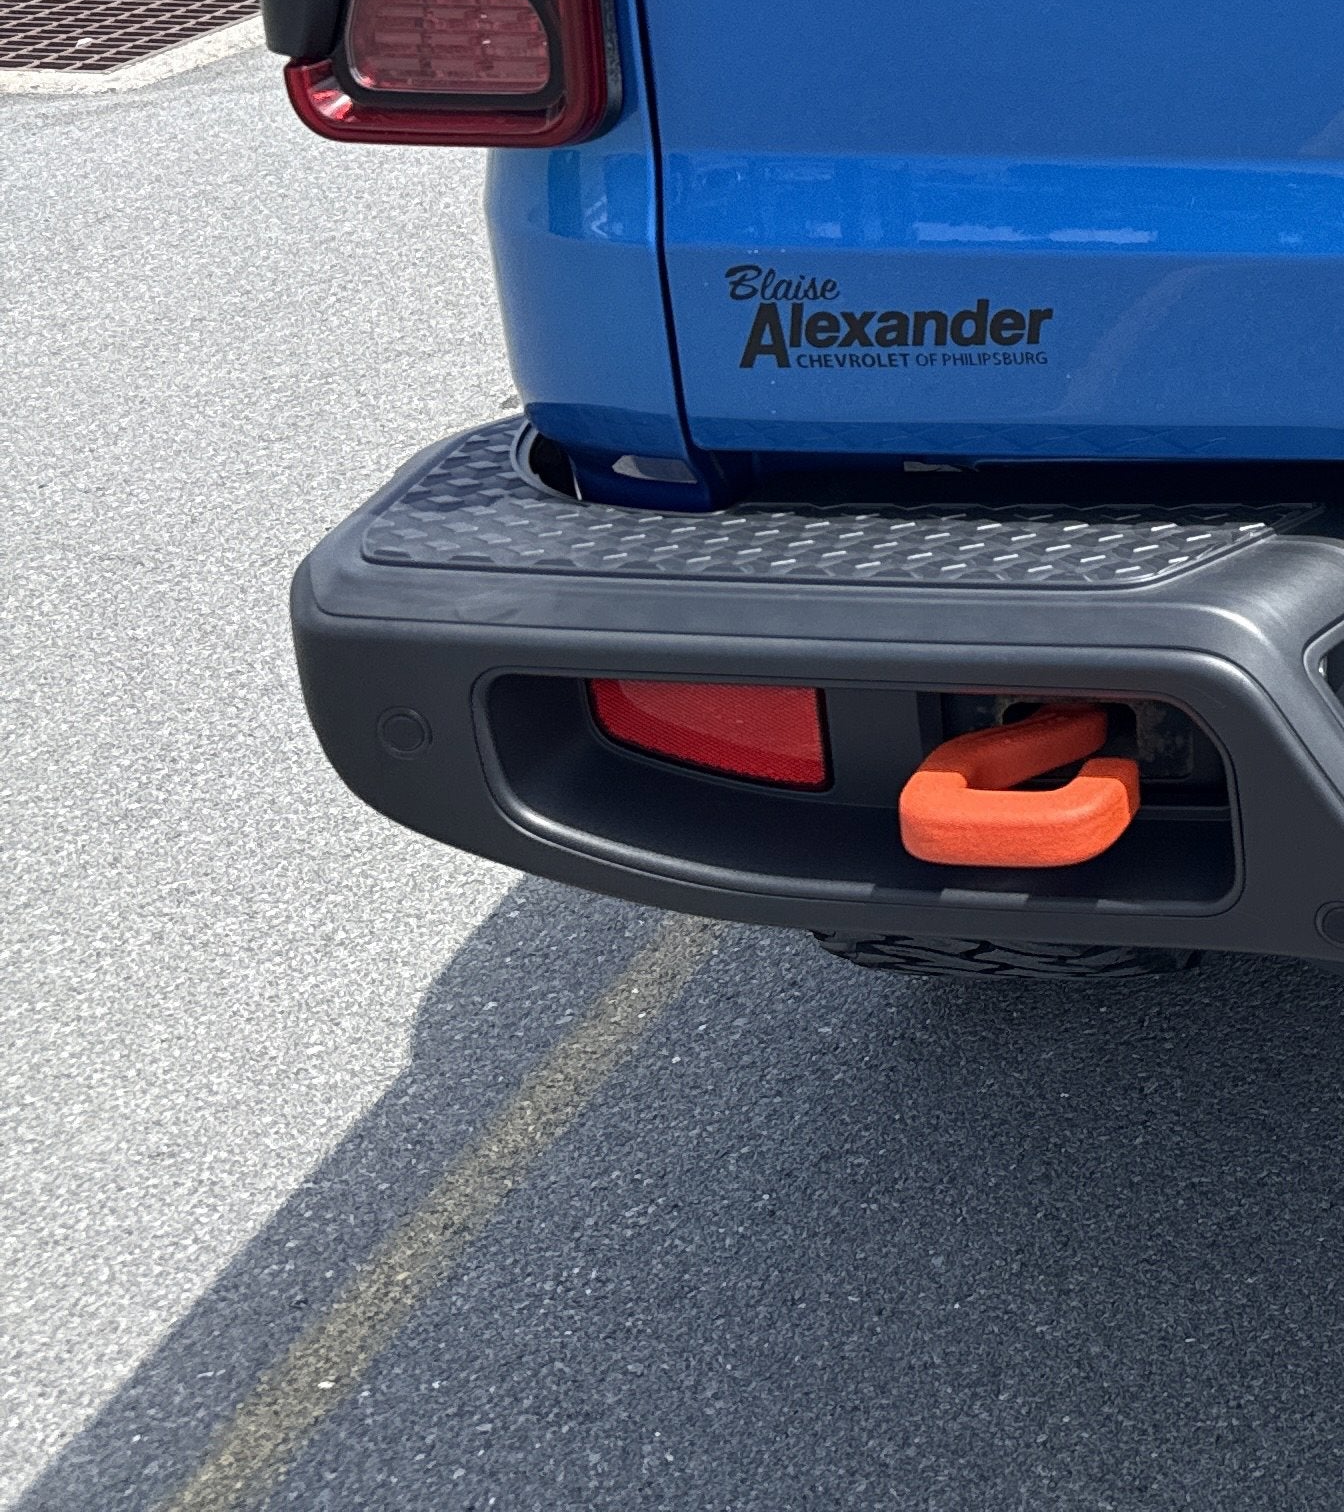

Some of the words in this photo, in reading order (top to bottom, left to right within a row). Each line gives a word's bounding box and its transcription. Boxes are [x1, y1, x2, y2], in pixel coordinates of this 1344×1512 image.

[725, 264, 840, 301] Blaise
[739, 298, 1053, 368] Alexander
[796, 353, 910, 368] CHEVROLET
[915, 353, 937, 366] OF
[942, 351, 1048, 366] PHILIPSBURG
